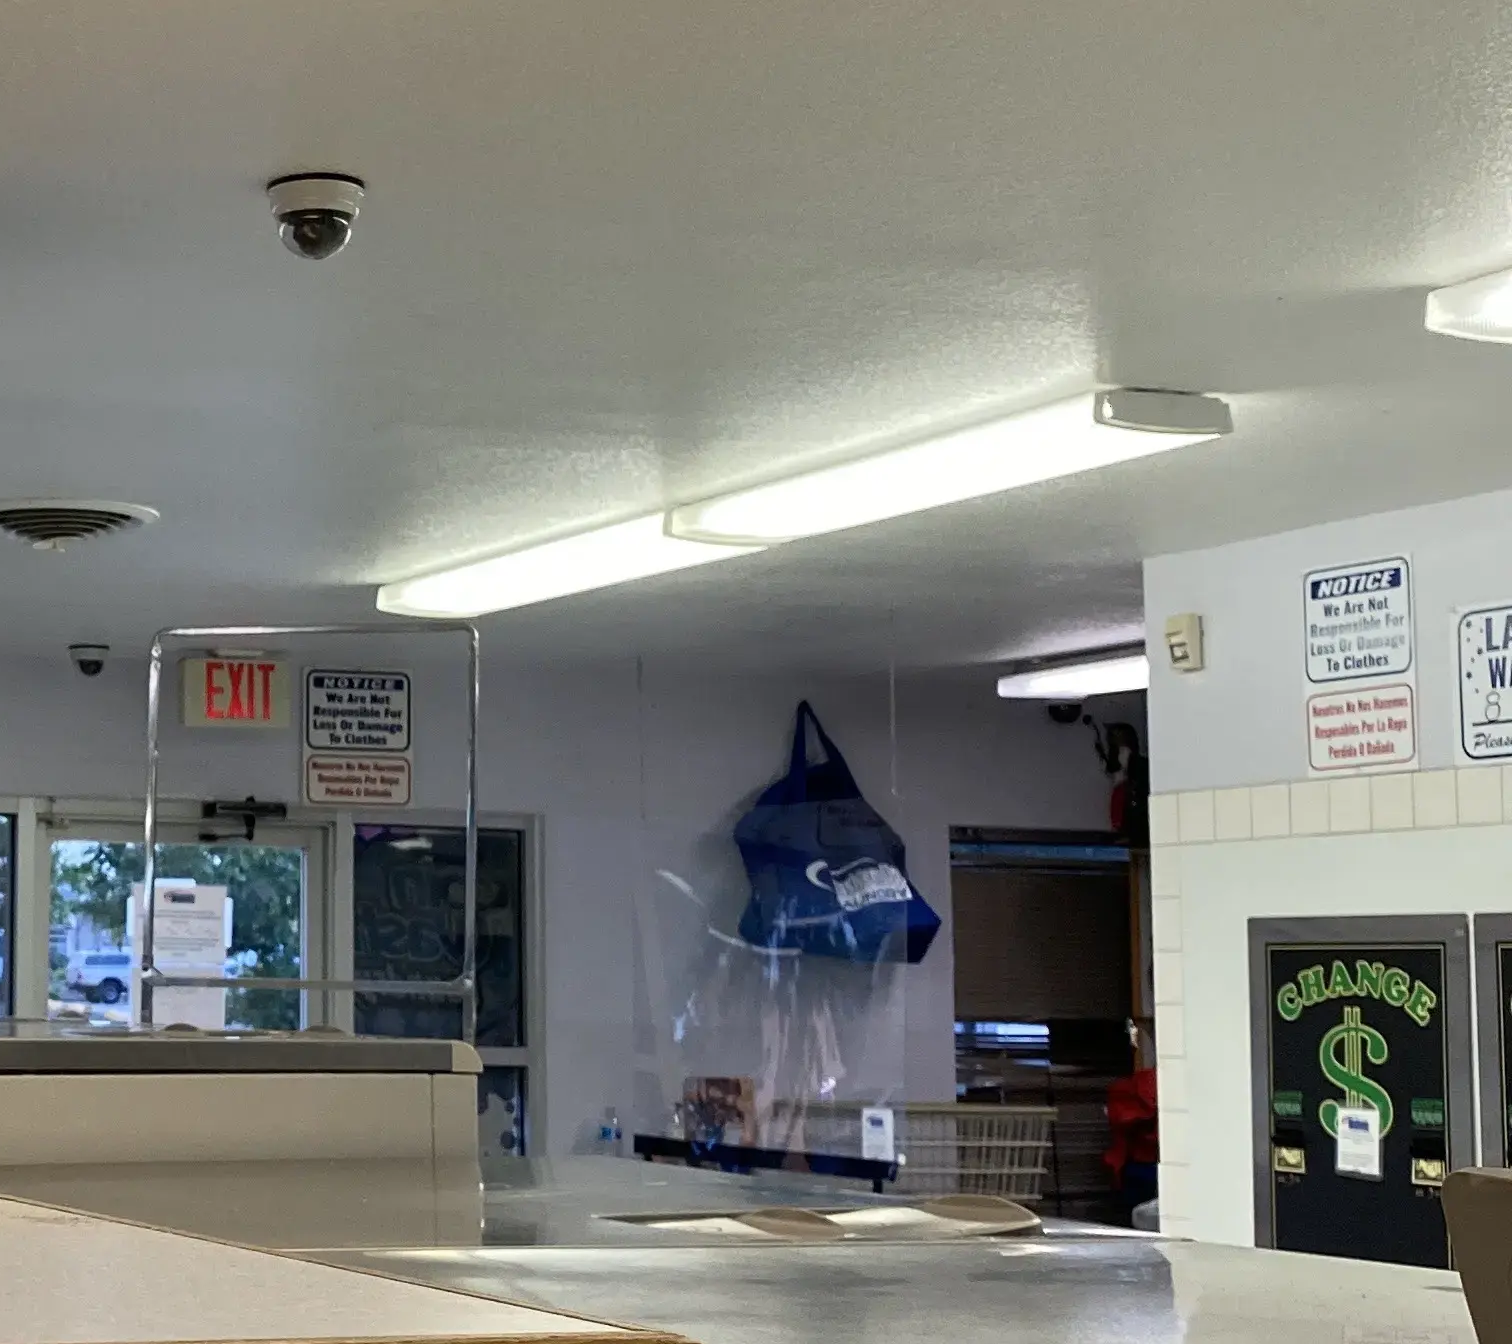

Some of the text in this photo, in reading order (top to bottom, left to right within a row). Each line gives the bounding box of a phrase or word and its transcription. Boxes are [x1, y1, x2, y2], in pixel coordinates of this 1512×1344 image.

[1317, 570, 1395, 599] NOTICE
[1323, 596, 1389, 617] We Are Not
[1310, 613, 1405, 638] Responsible For
[1310, 632, 1406, 656] Loss Or Damage
[1326, 653, 1389, 673] To Clothes
[205, 661, 276, 720] EXIT
[1277, 958, 1437, 1027] CHANGE
